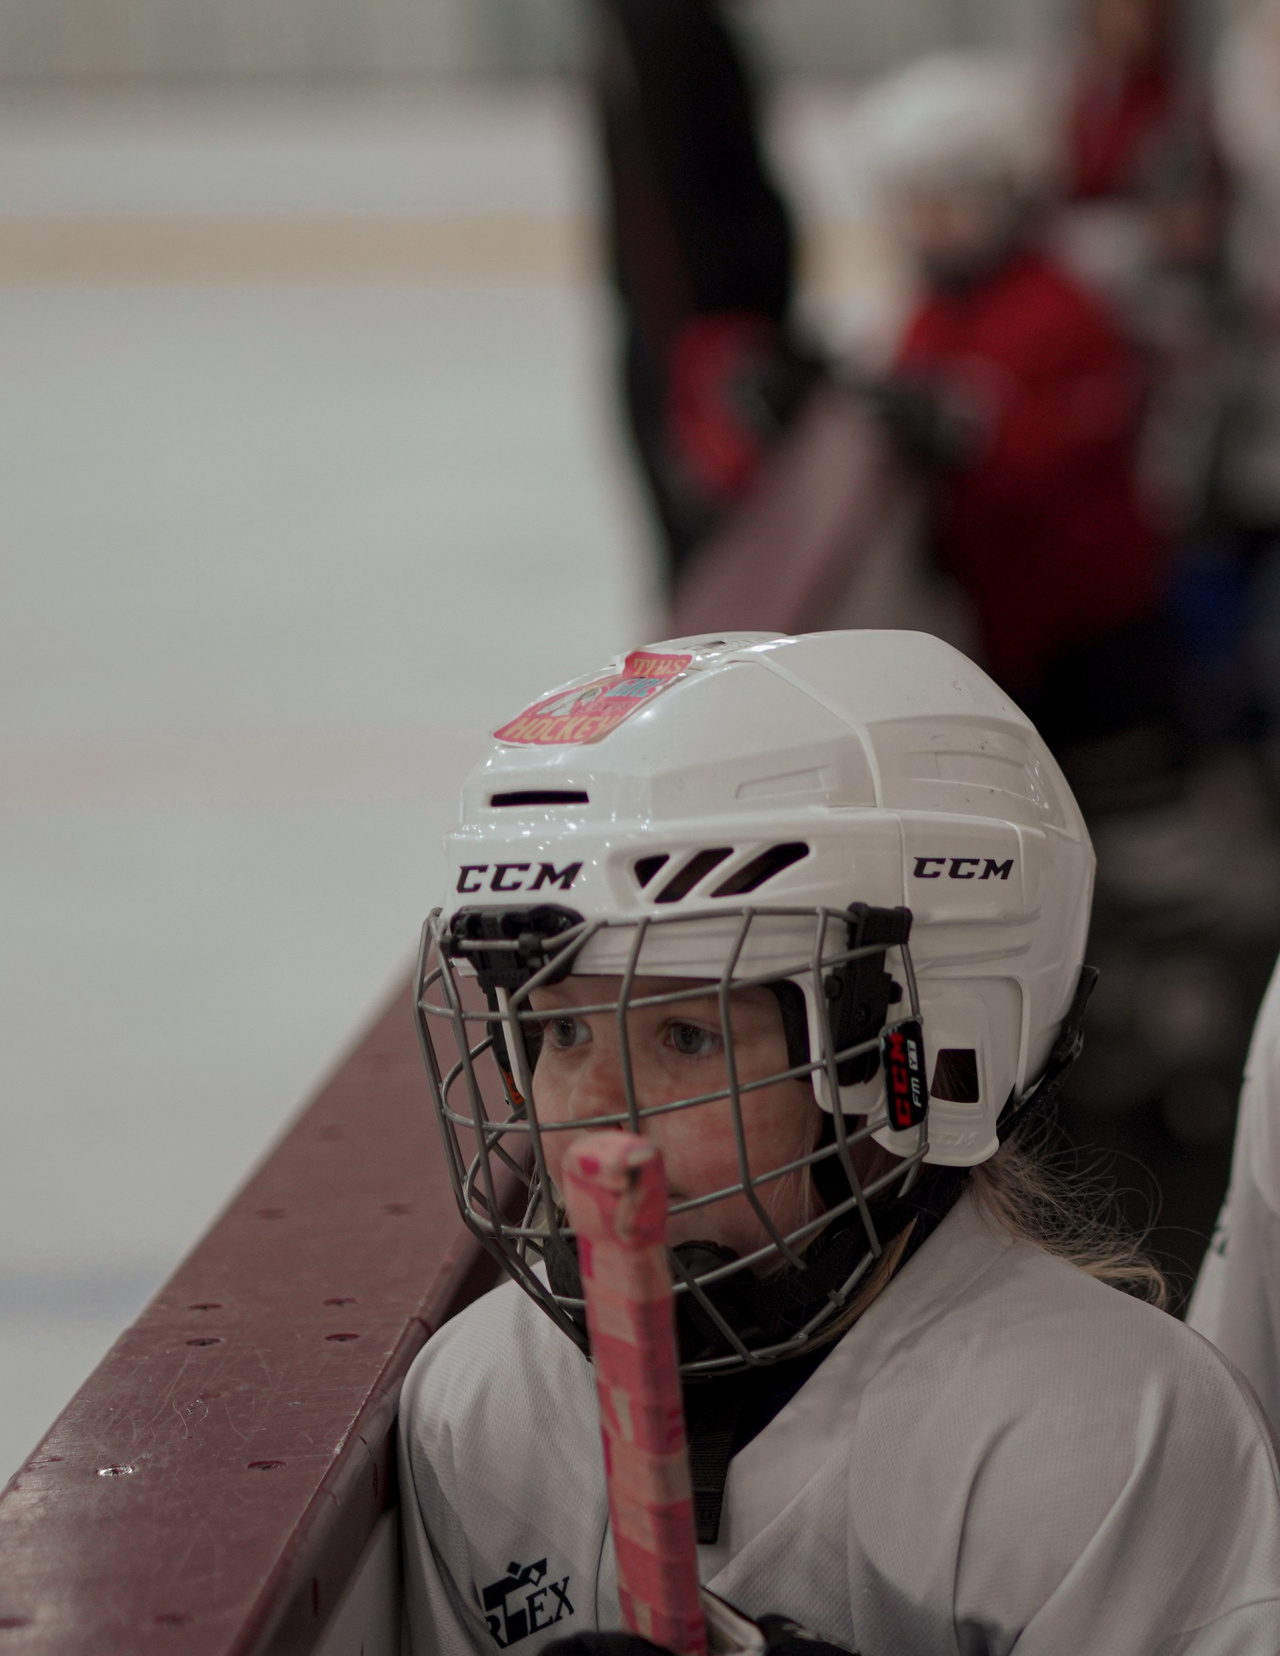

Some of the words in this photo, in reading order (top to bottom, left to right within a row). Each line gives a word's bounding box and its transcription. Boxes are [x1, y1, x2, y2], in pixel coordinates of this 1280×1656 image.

[502, 714, 622, 742] HOCKEY
[455, 861, 583, 893] CCM
[912, 856, 1015, 880] CCM
[887, 1031, 913, 1128] CCM
[910, 1077, 922, 1108] FM
